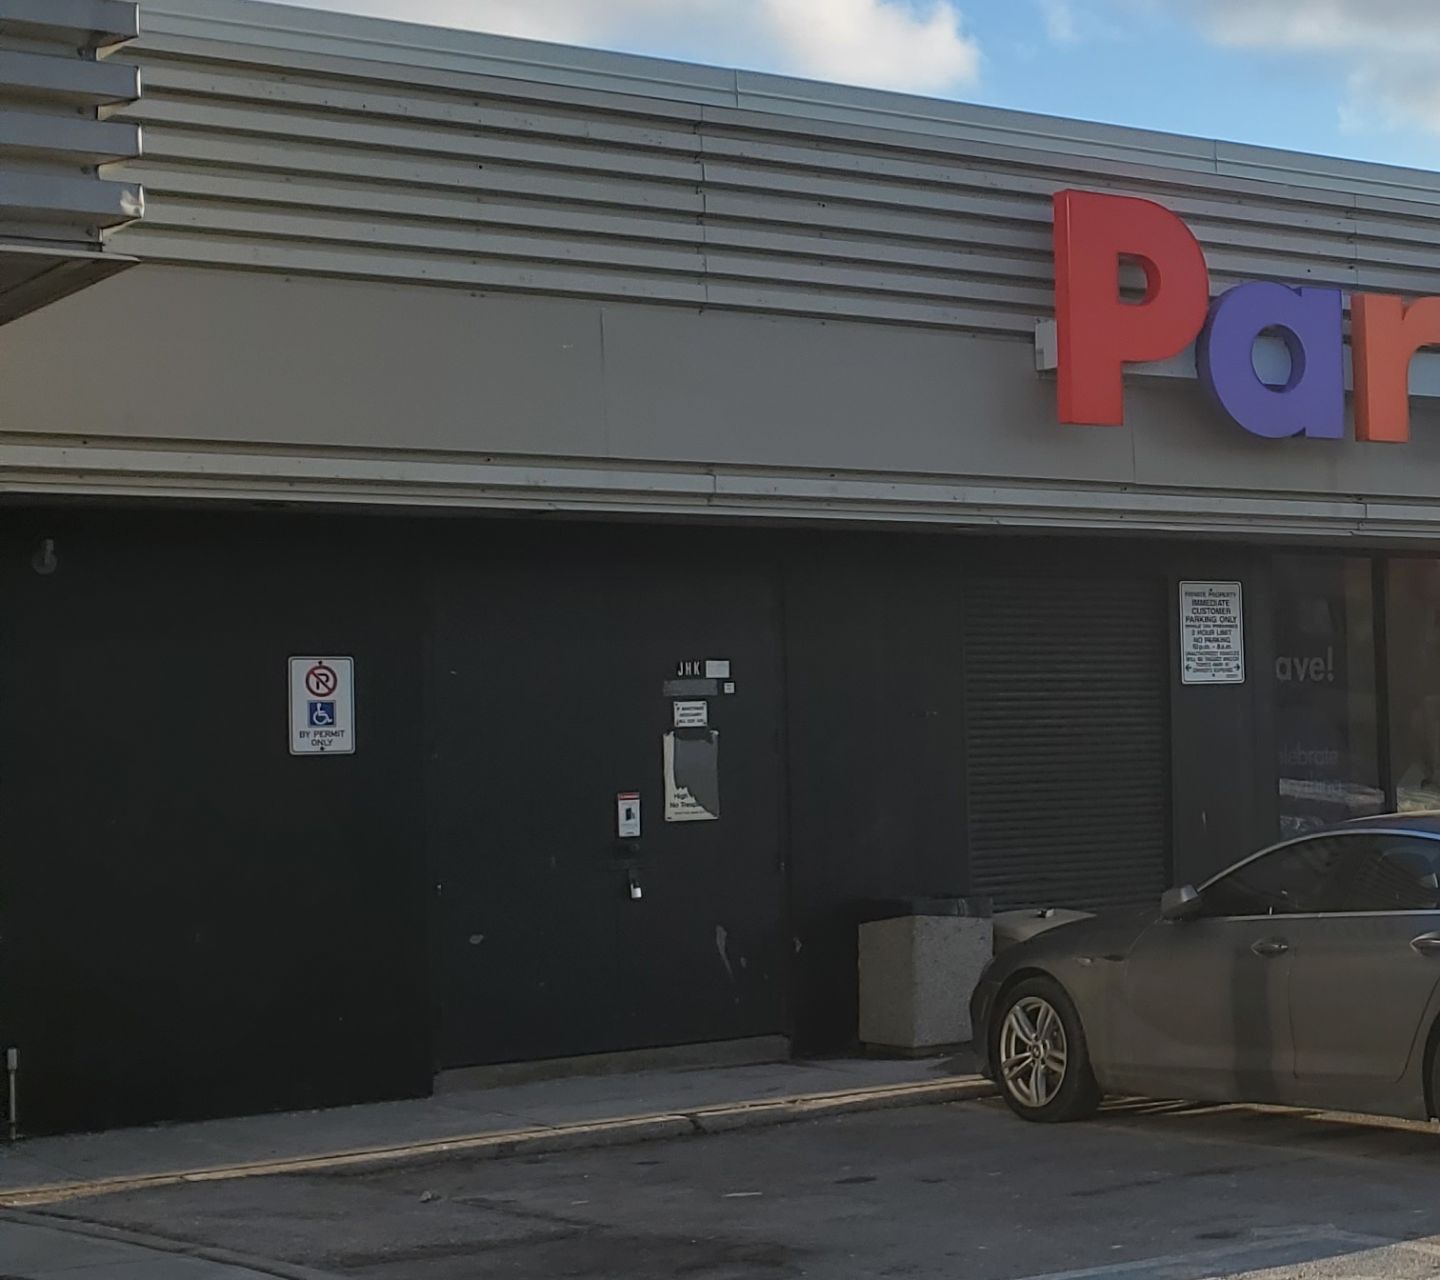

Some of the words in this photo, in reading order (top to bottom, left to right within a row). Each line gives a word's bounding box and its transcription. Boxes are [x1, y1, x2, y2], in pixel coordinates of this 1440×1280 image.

[1191, 607, 1231, 615] CUSTOMER
[1185, 615, 1217, 623] PARKING
[1219, 615, 1237, 623] ONLY
[299, 730, 311, 738] BY
[313, 729, 345, 738] PERMIT
